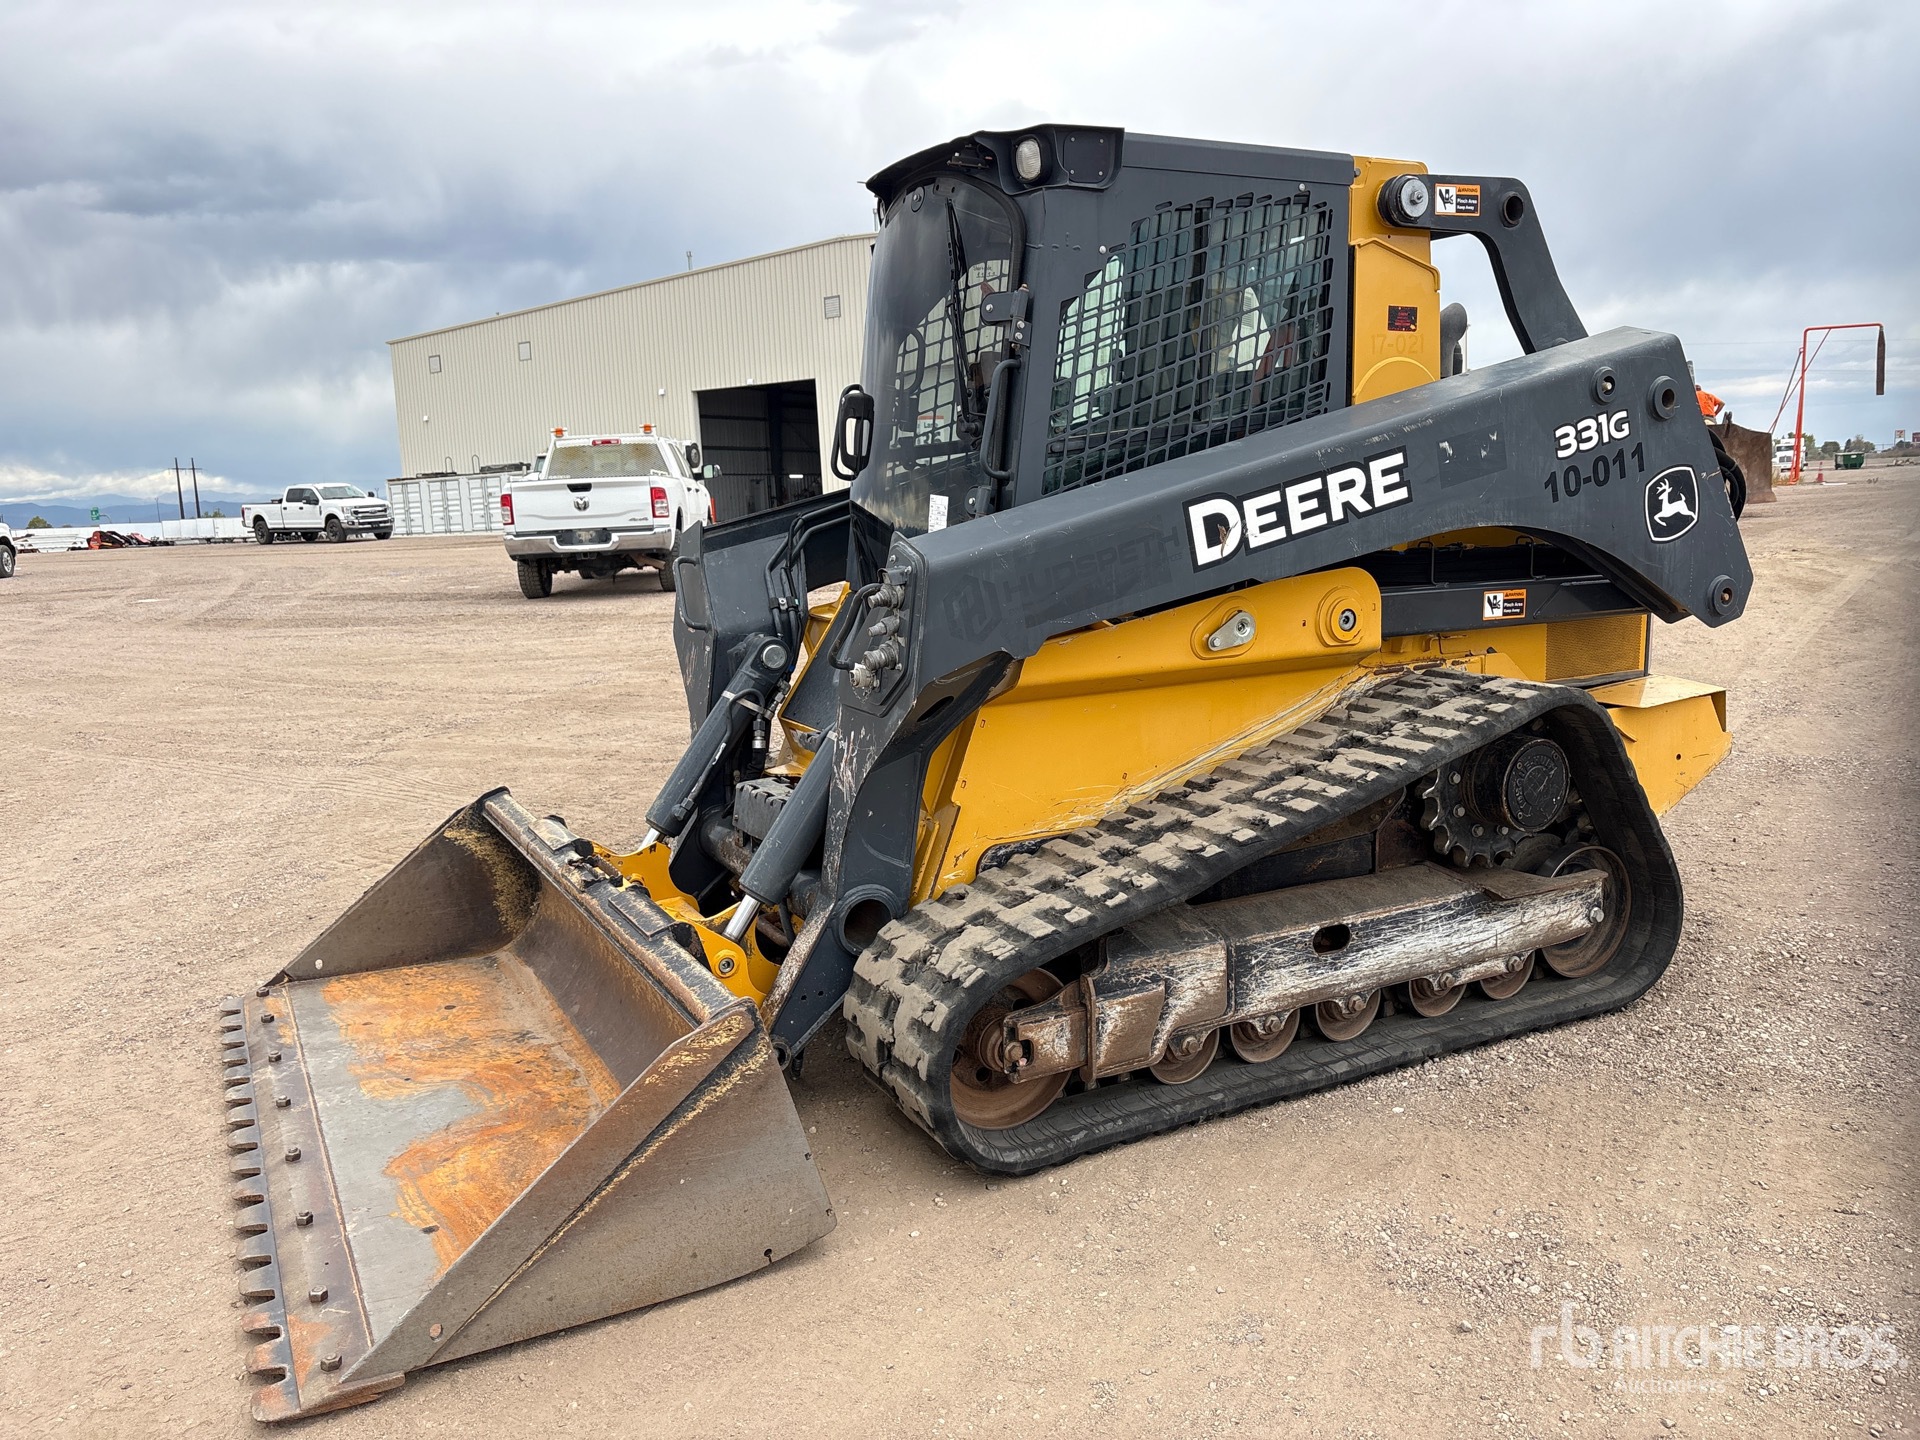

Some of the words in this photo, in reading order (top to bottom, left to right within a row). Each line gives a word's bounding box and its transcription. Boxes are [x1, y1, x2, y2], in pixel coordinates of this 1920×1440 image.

[1371, 333, 1425, 354] 17-021
[1554, 410, 1631, 459] 331G
[1544, 442, 1645, 503] 10-011
[1187, 452, 1409, 567] DEERE
[1003, 526, 1181, 597] HUDSPETH
